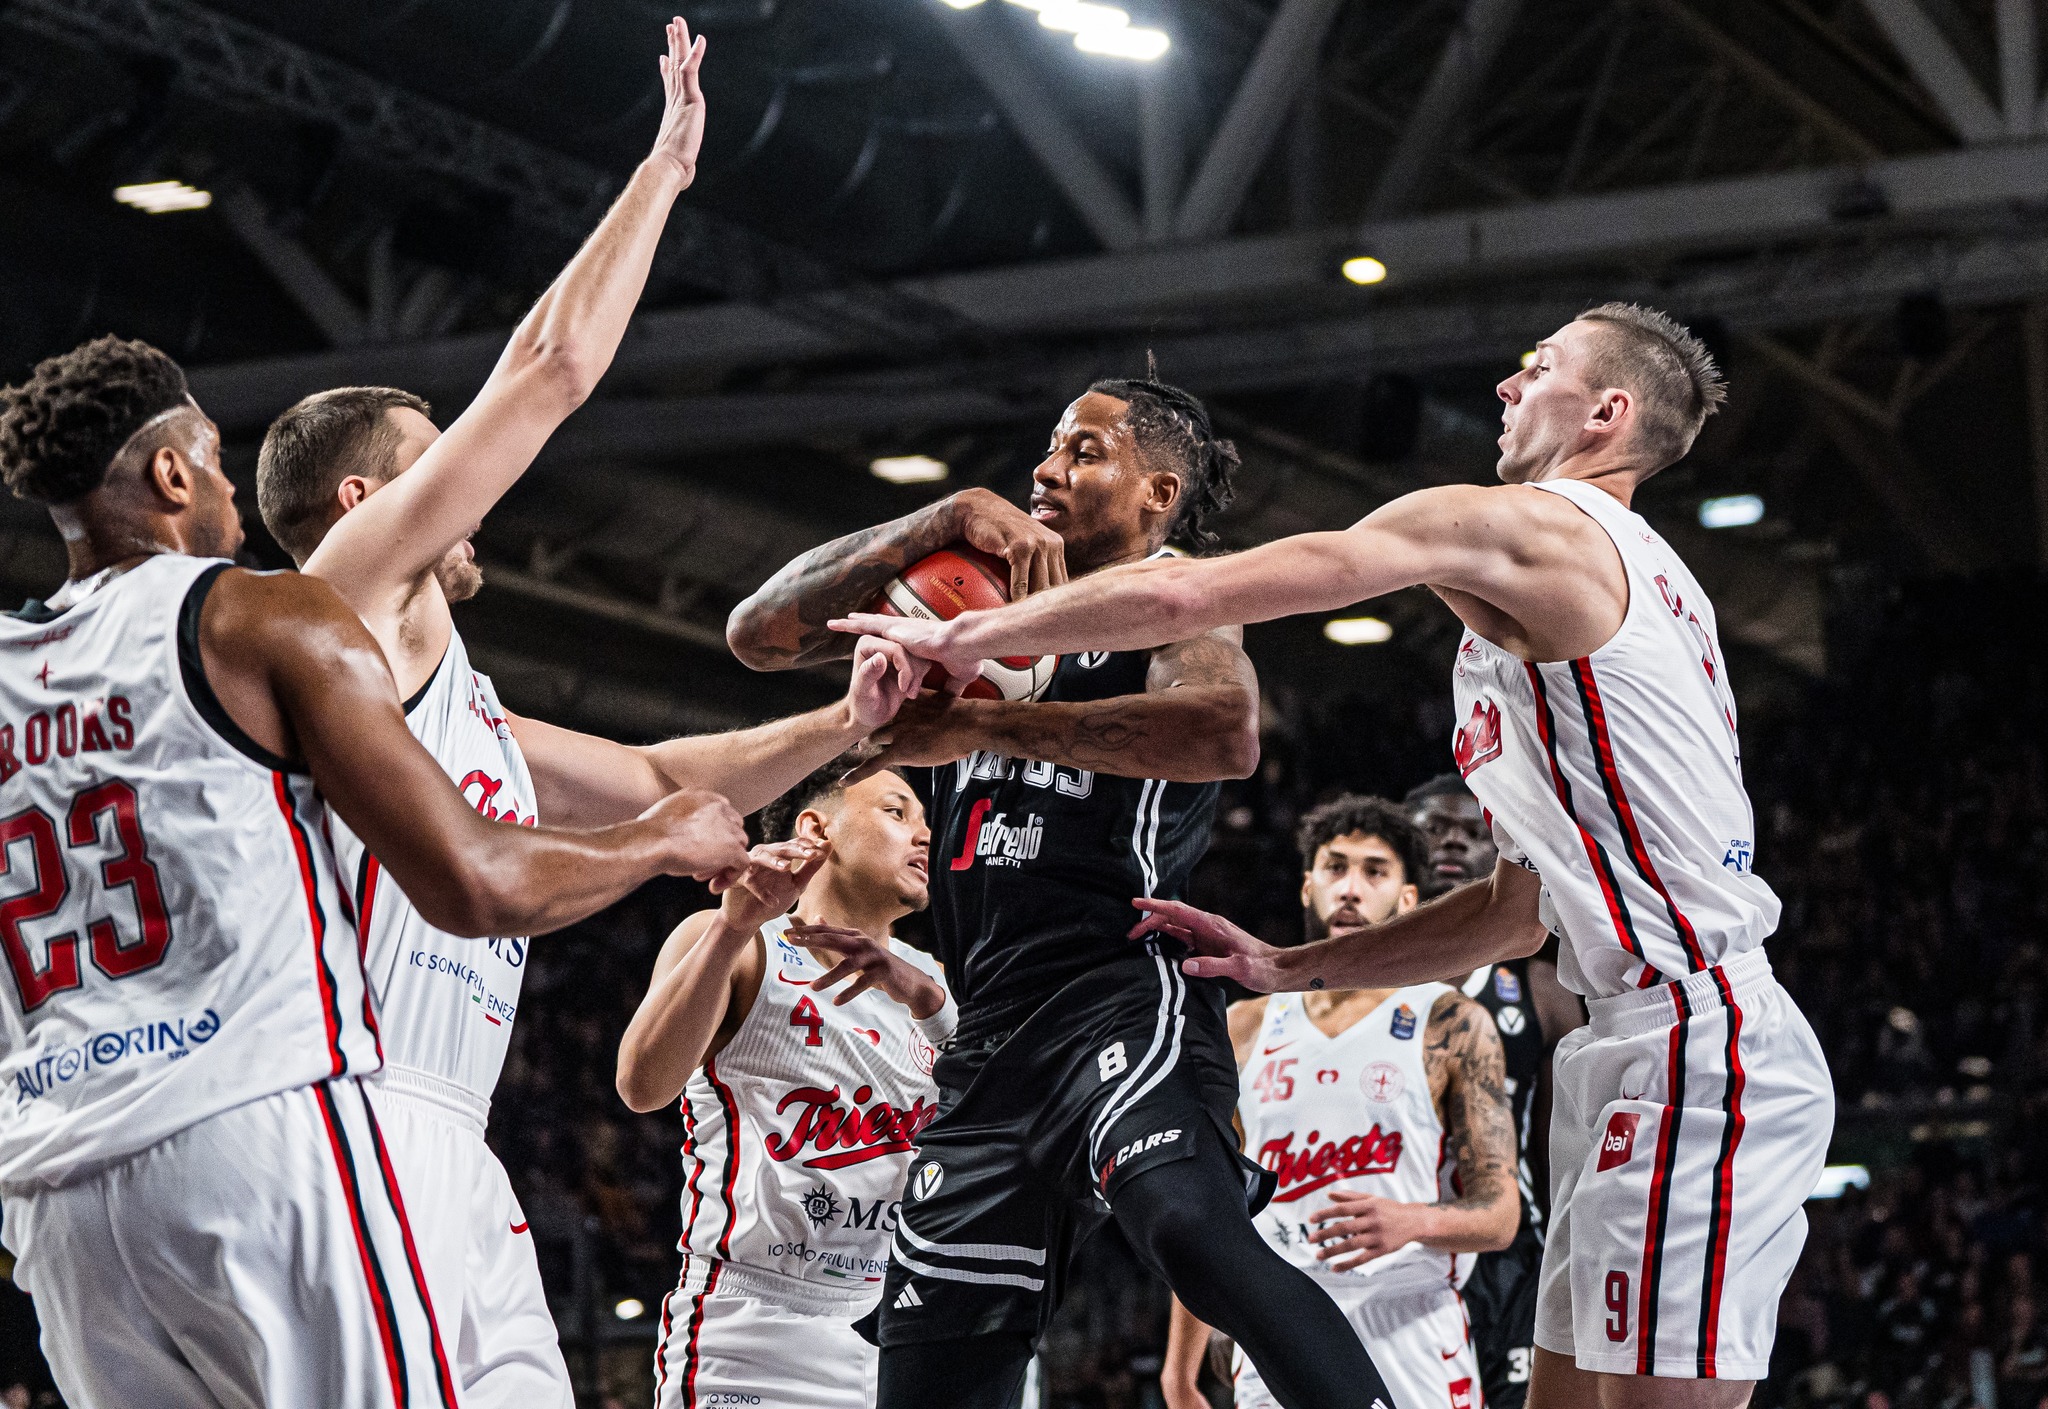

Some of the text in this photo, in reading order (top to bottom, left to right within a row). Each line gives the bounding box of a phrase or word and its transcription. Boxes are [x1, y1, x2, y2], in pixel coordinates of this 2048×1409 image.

[0, 696, 134, 785] ROOKS
[986, 856, 1021, 868] ANETTI
[0, 776, 173, 1014] 23
[790, 994, 824, 1047] 4
[16, 1008, 220, 1105] AUTOTORINO
[1098, 1041, 1128, 1082] 8
[1253, 1058, 1299, 1103] 45
[1605, 1130, 1630, 1152] bai
[842, 1196, 902, 1232] MS
[768, 1244, 784, 1257] IO
[817, 1252, 855, 1271] FRIULI
[859, 1258, 889, 1274] VENE
[1605, 1269, 1630, 1342] 9
[1507, 1346, 1535, 1383] 3
[723, 1394, 760, 1405] SONO
